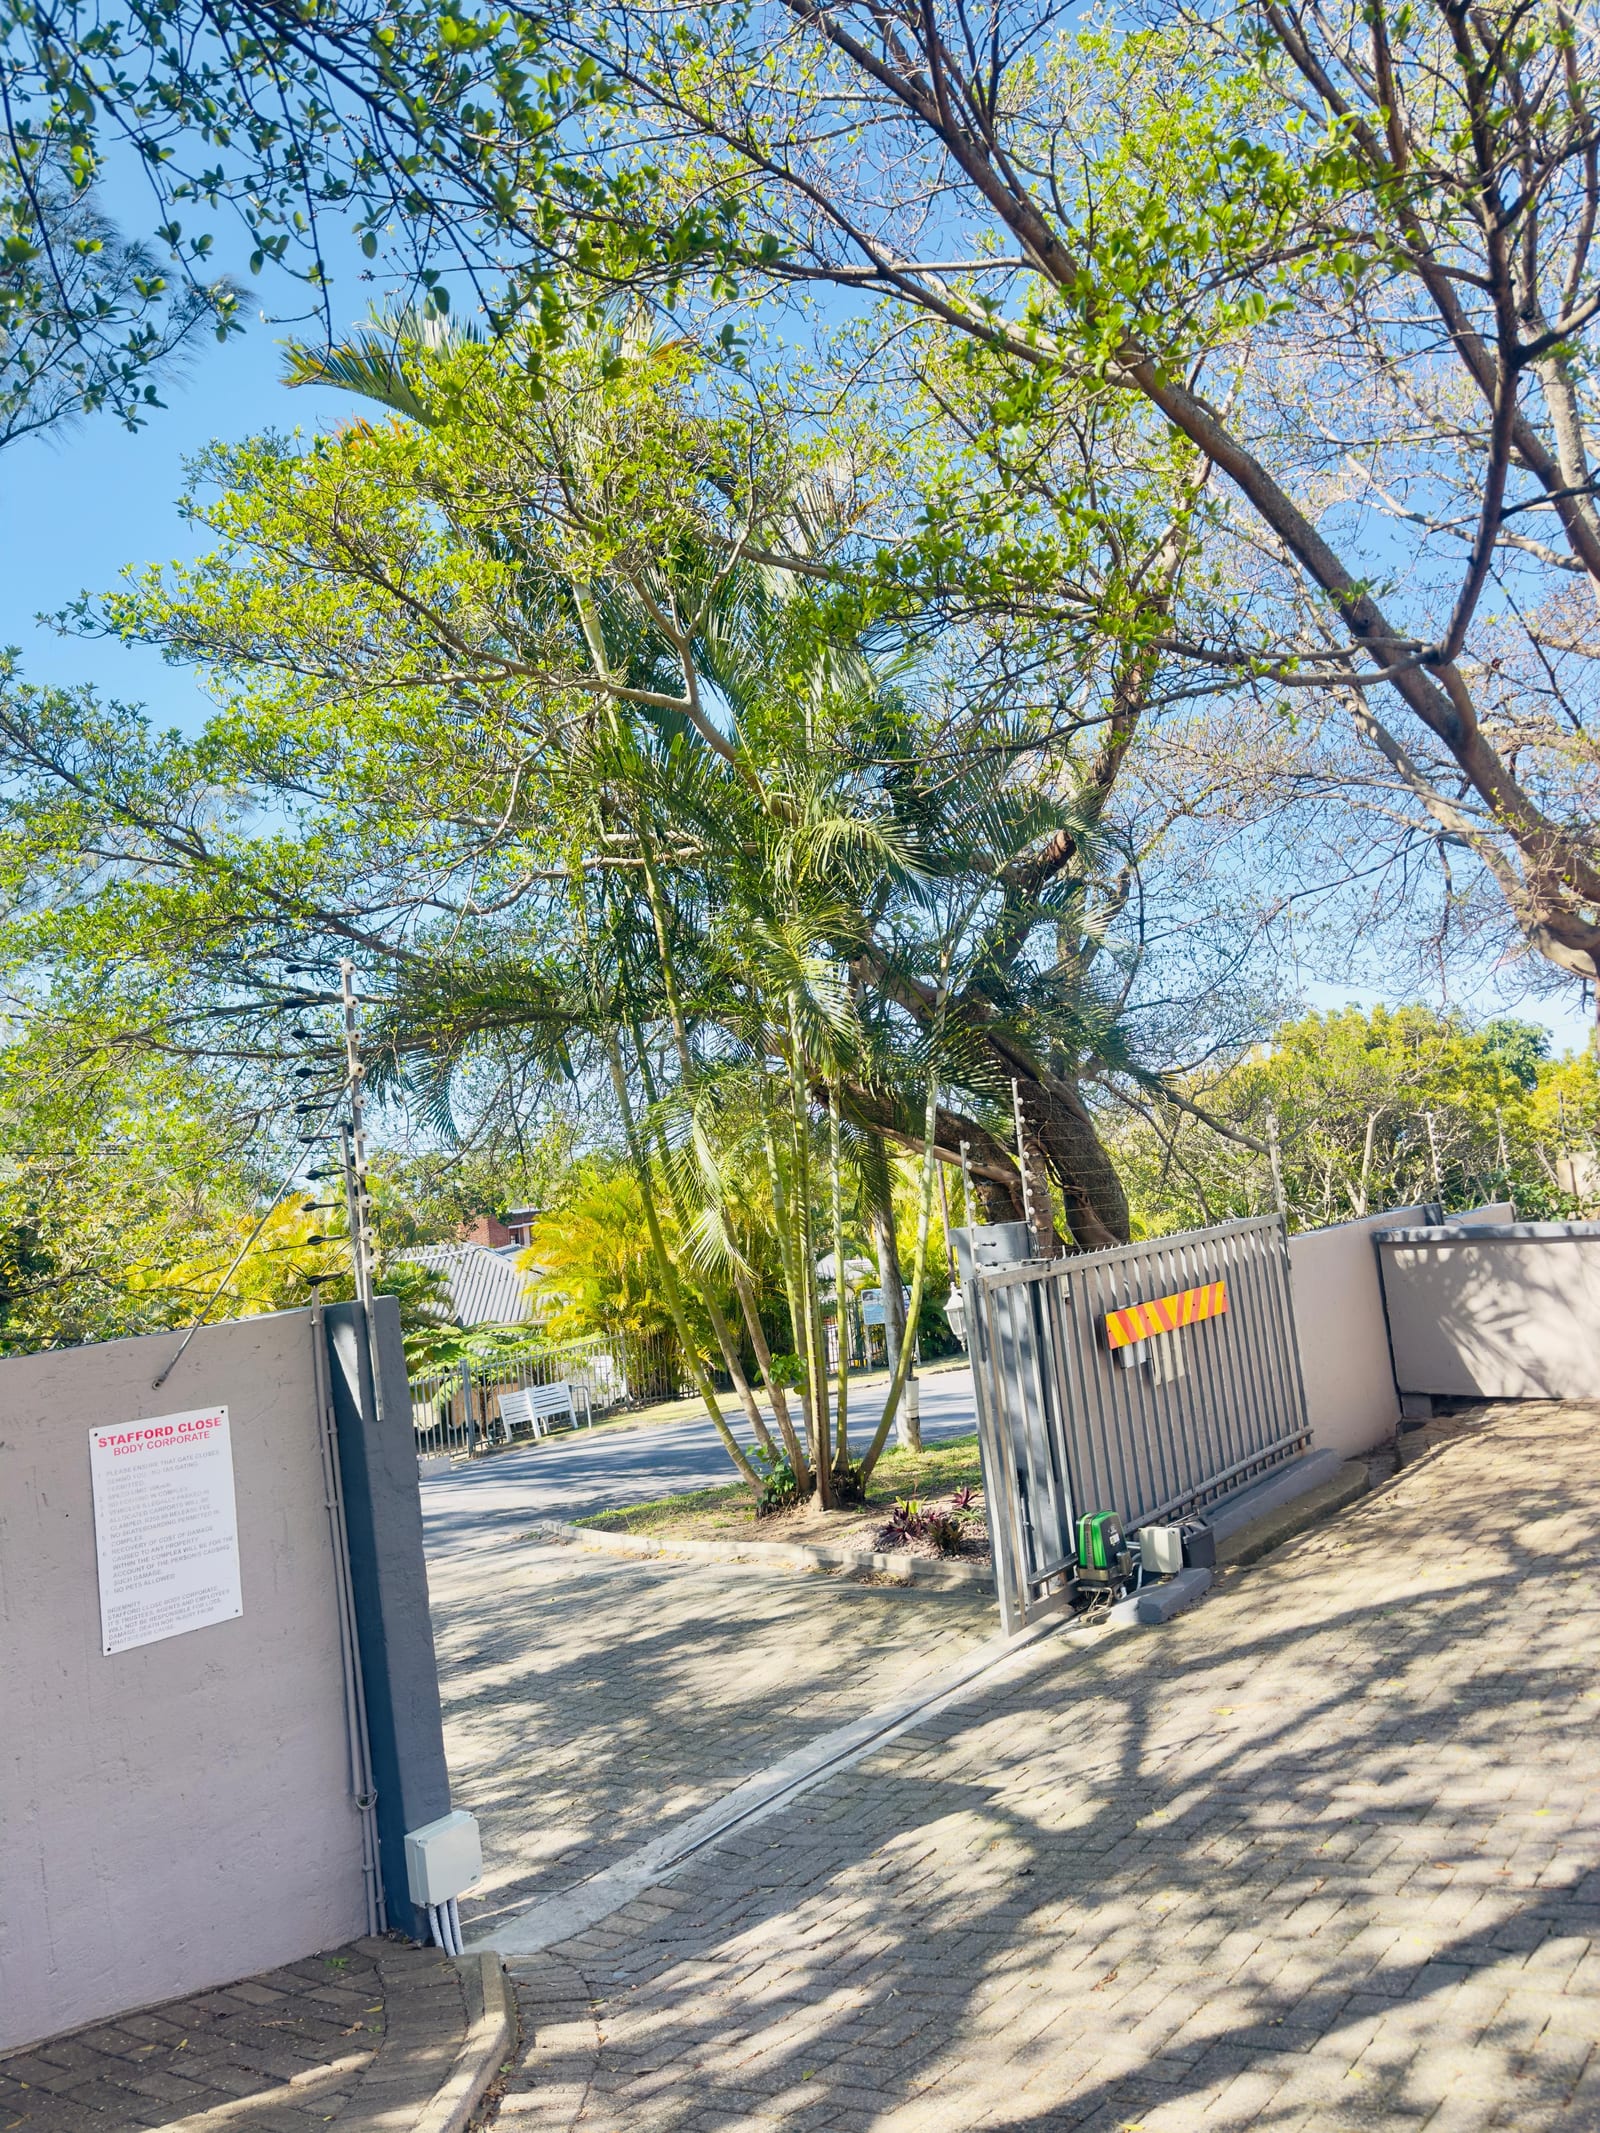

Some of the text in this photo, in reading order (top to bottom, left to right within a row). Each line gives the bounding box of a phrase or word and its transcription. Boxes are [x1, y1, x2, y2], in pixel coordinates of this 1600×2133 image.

[98, 1417, 222, 1448] STAFFORD CLOSE
[114, 1430, 210, 1456] BODY CORPORATE
[152, 1549, 181, 1561] COMPLEX
[113, 1566, 144, 1579] ACCOUNT
[126, 1582, 142, 1591] PETS
